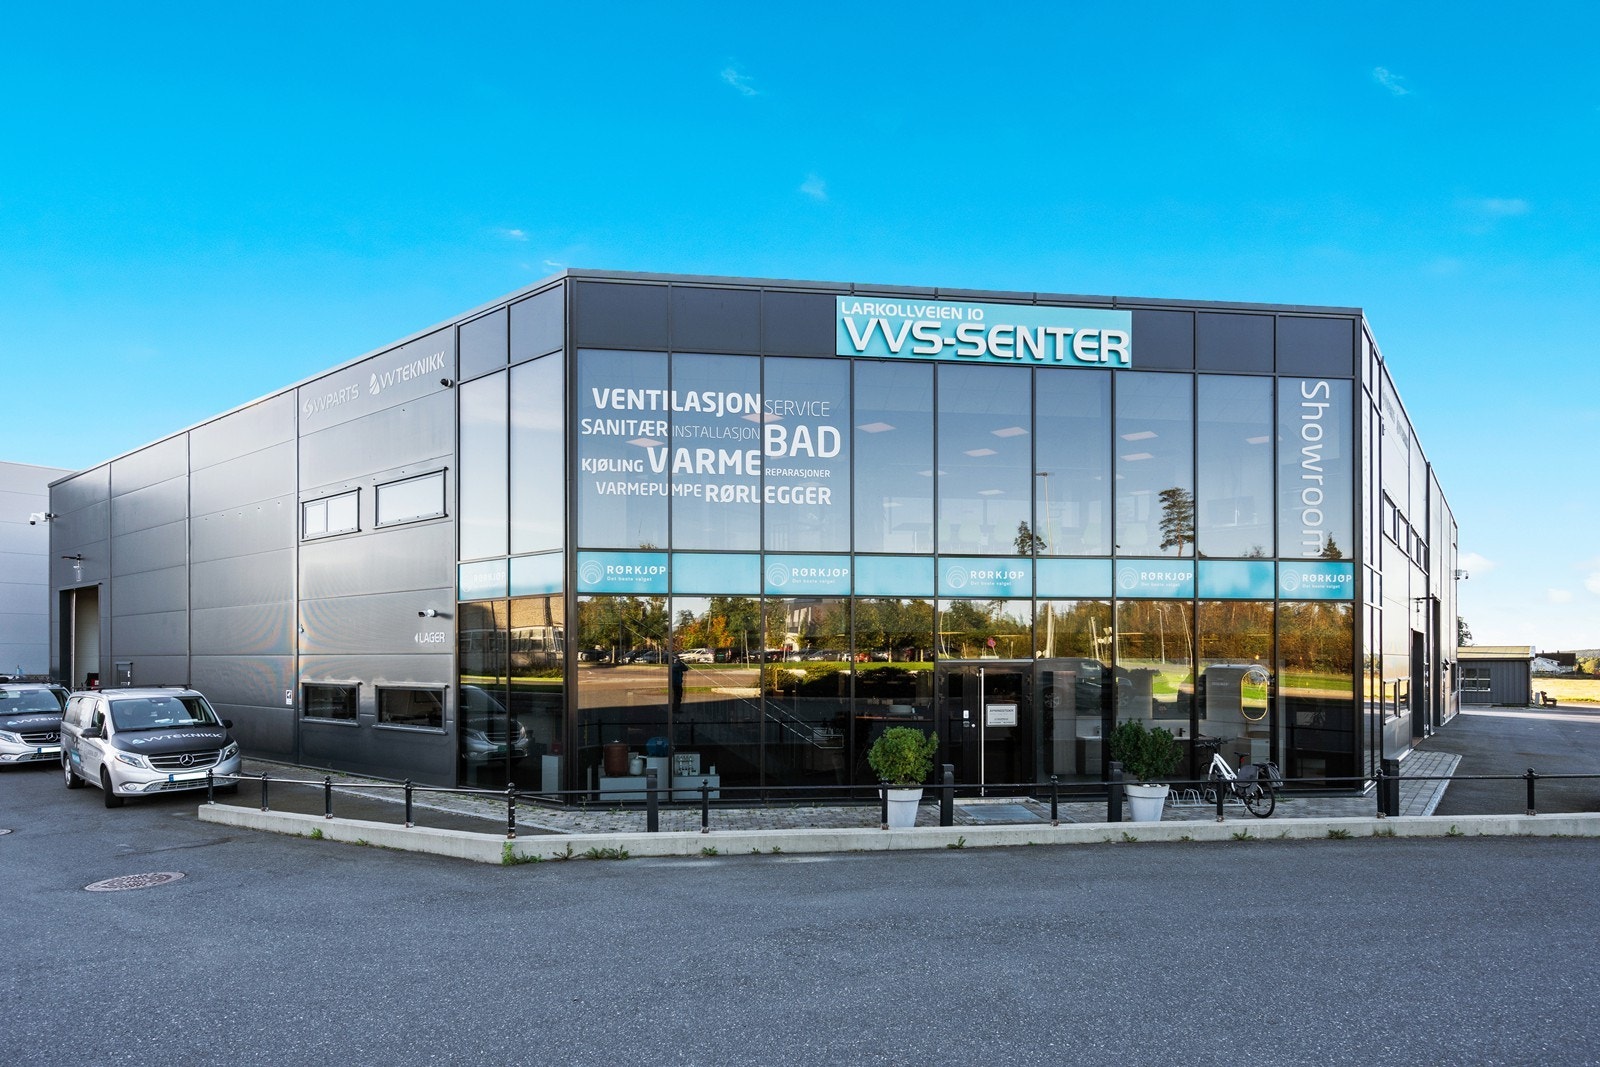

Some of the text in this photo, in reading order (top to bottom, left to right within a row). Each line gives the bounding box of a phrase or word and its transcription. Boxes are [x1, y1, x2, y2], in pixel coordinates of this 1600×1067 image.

[841, 301, 963, 320] LARKOLLVEIEN
[843, 316, 1130, 363] VVS-SENTER
[592, 387, 830, 417] VENTILASJON SERVICE
[581, 418, 760, 442] SANITÆR INSTALLASJON
[764, 424, 841, 458] BAD
[581, 446, 761, 476] KJØLING VARME
[1301, 380, 1330, 558] Showroom
[765, 467, 831, 478] REPARASJONER
[596, 481, 832, 505] VARMEPUMPE RØRLEGGER
[606, 565, 666, 575] RØRKJØP
[792, 567, 849, 577] RØRKJØP
[970, 570, 1025, 580] RØRKJØP
[1141, 571, 1193, 581] RØRKJØP
[1302, 574, 1352, 583] RØRKJØP
[419, 632, 445, 643] LAGER
